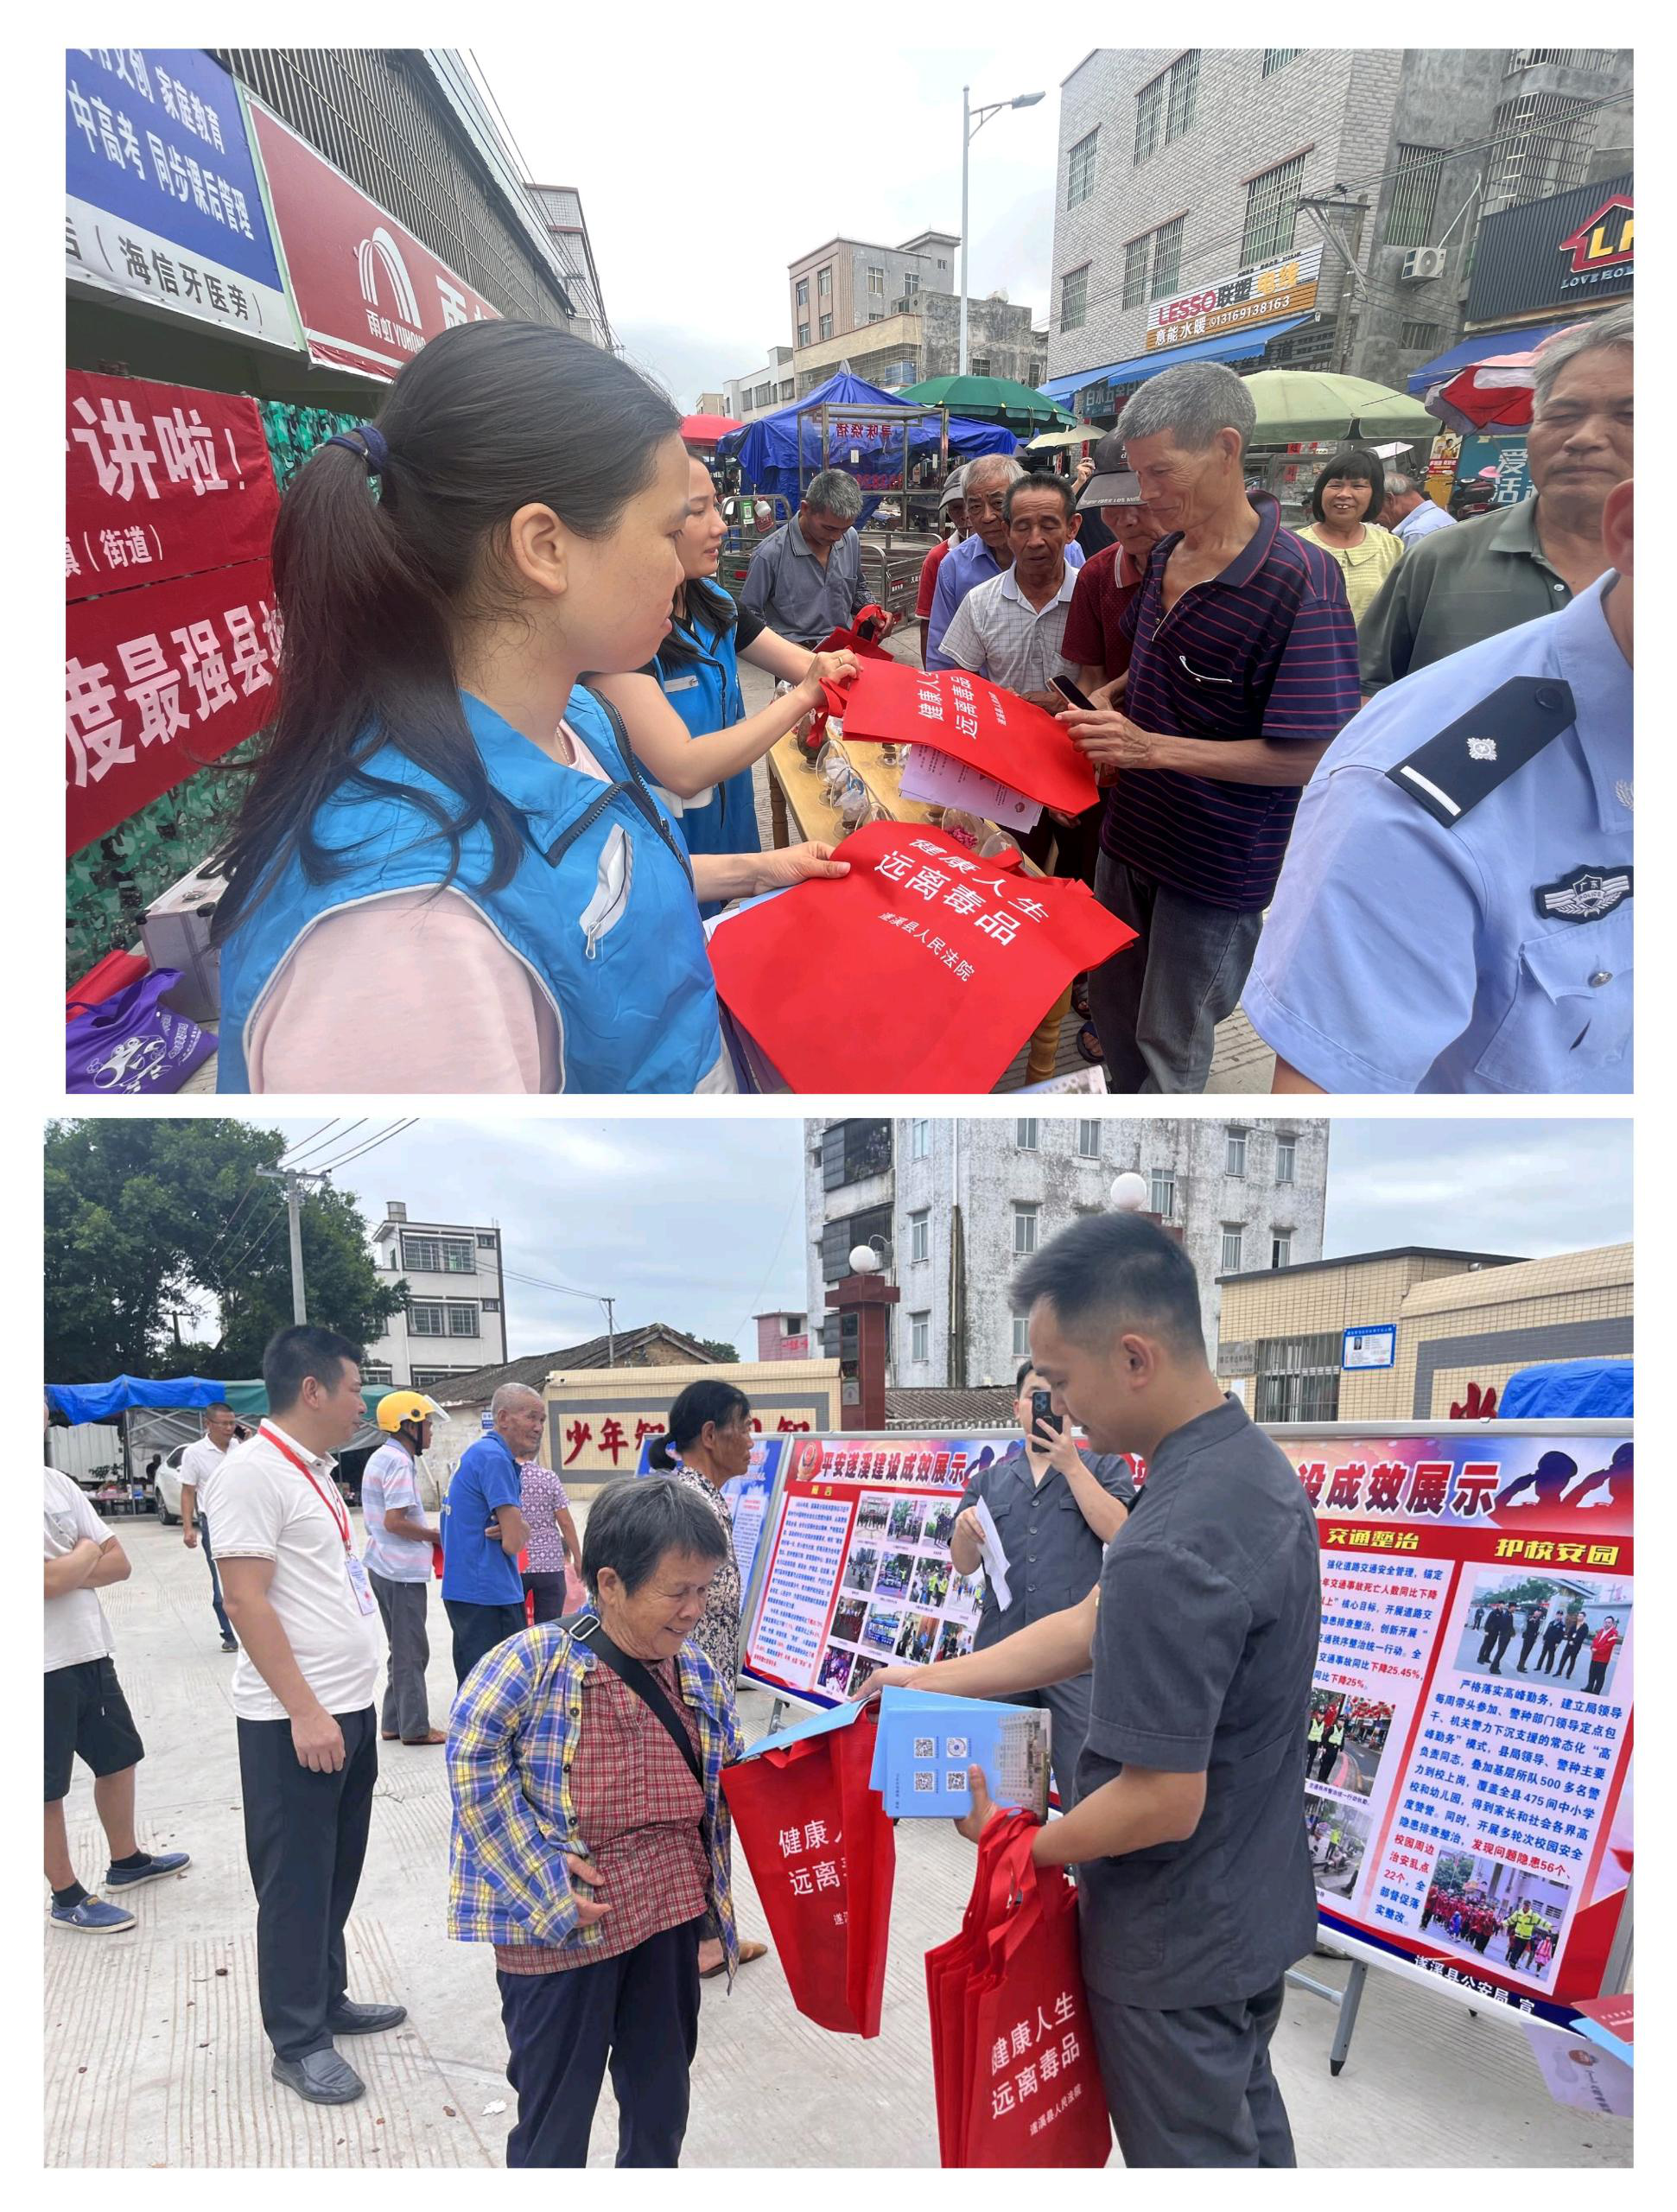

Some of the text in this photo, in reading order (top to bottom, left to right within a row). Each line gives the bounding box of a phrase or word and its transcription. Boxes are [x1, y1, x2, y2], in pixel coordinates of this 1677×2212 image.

[156, 66, 226, 155] 家庭教育
[67, 79, 255, 241] 中高考 同步课后管理
[435, 274, 488, 330] 雨
[1154, 296, 1291, 346] 意能水暖 13169138163
[1159, 289, 1216, 326] LESSO
[1258, 262, 1300, 296] 电线
[365, 308, 395, 345] 雨虹
[66, 397, 245, 502] 讲啦！
[950, 676, 978, 740] 远离毒品
[874, 850, 1022, 947] 远离毒品
[909, 837, 1050, 924] 健康人生
[878, 911, 975, 982] 遂溪县人民法院
[820, 1451, 968, 1485] 平安遂溪建设成效展示
[1326, 1527, 1420, 1551] 交通整治
[1495, 1537, 1620, 1567] 护校安园
[1320, 1577, 1438, 1600] 年交通事故死亡人数同比下降
[1389, 1850, 1431, 1874] 治安乱点
[1394, 1833, 1436, 1857] 校园周边
[787, 1855, 848, 1897] 远离
[1379, 1885, 1421, 1910] 部督促落
[991, 1989, 1077, 2075] 健康人生
[991, 2031, 1081, 2120] 远离毒品
